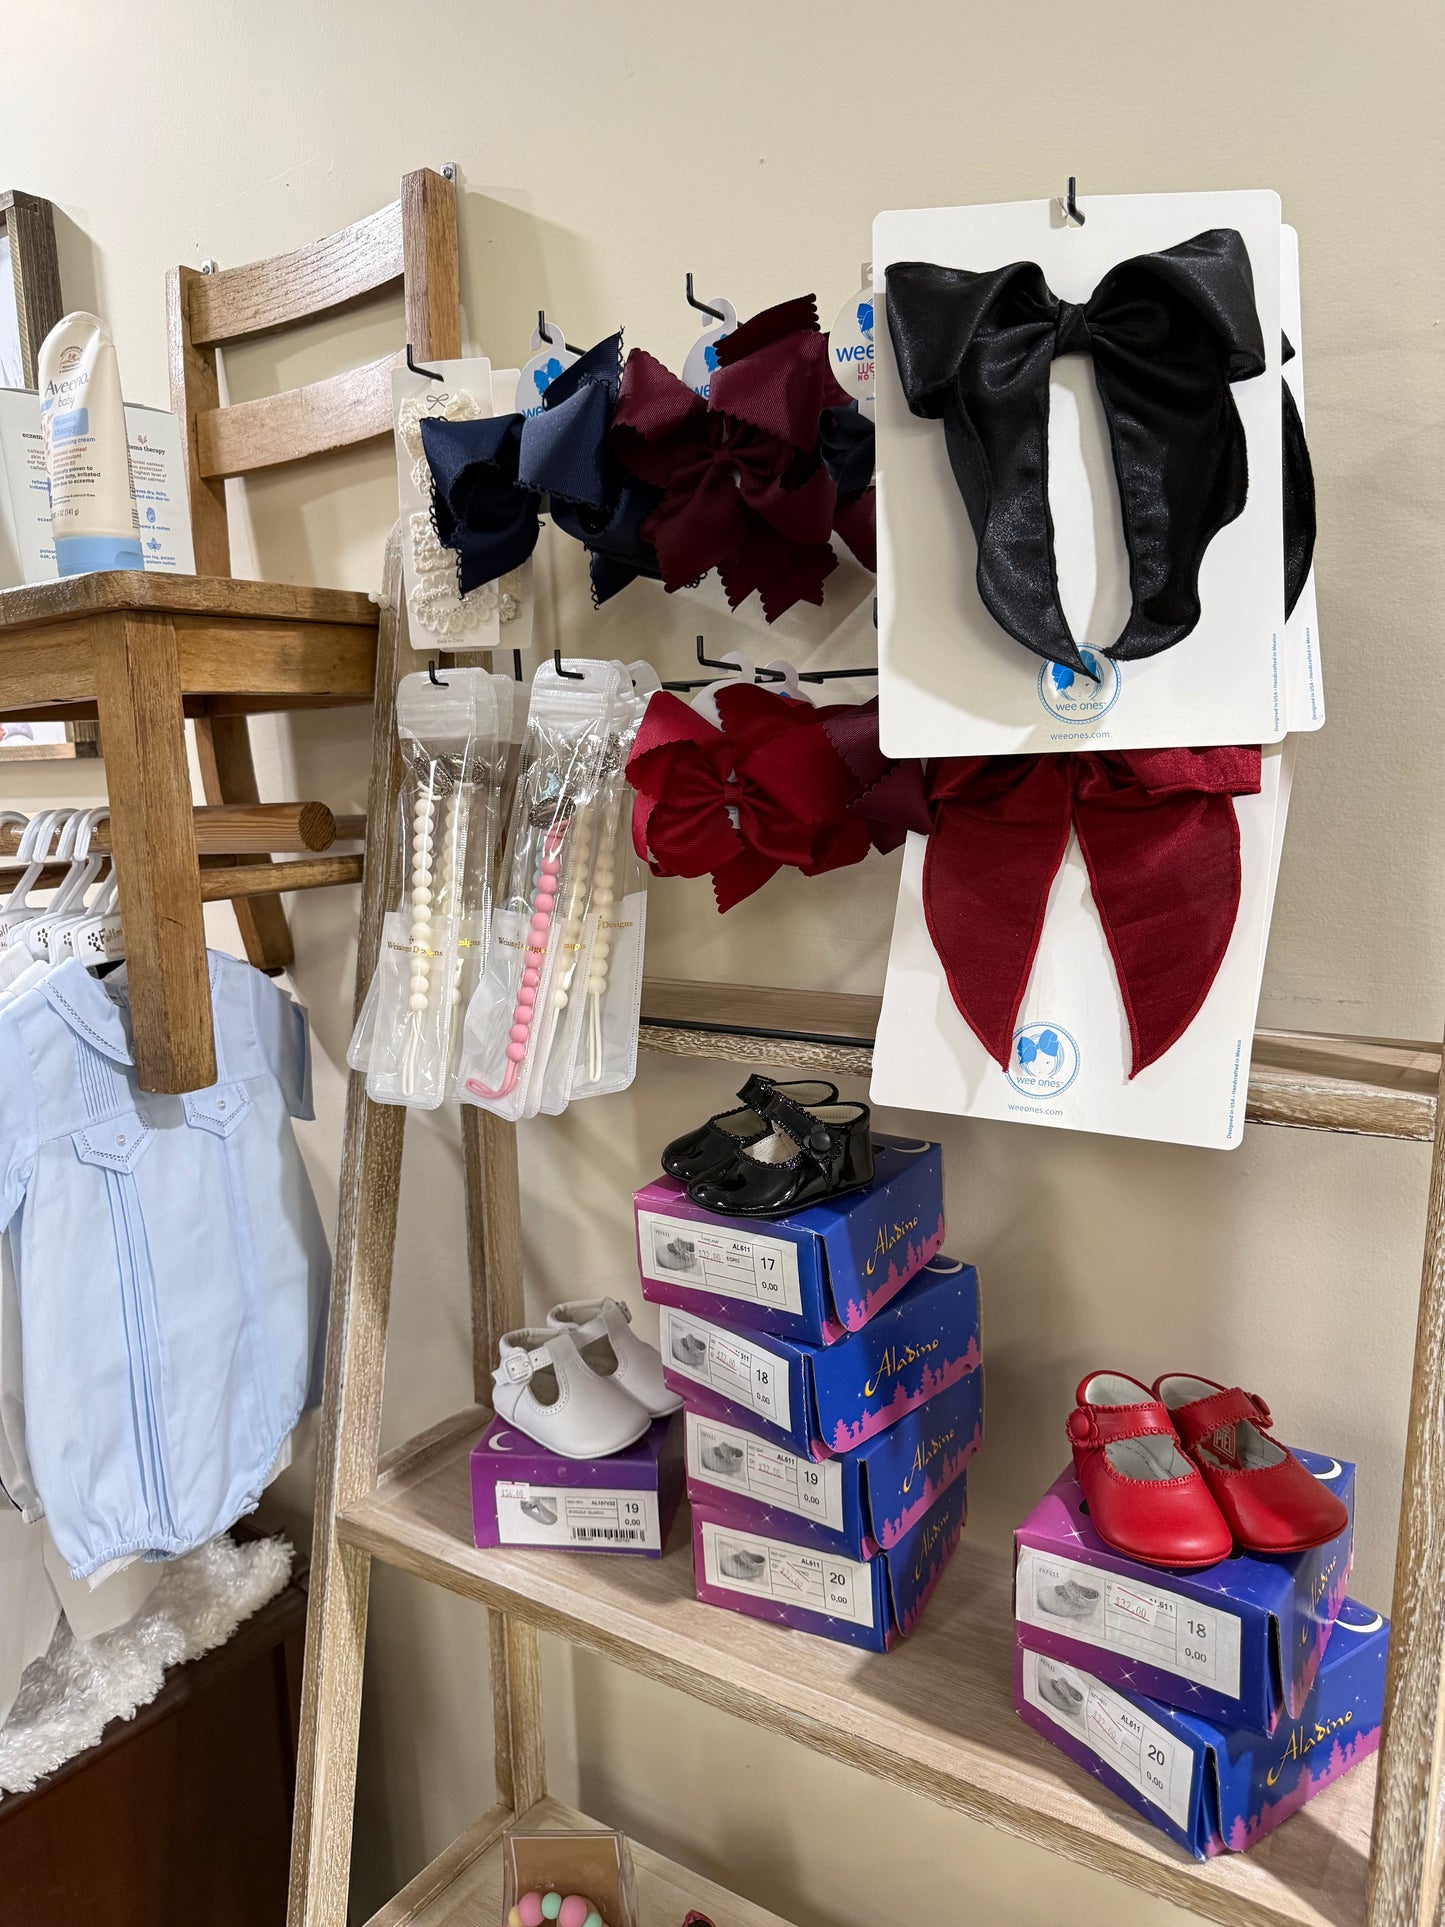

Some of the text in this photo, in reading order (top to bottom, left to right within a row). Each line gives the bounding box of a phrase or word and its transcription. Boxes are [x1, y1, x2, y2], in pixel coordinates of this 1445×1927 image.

[1055, 702, 1104, 711] wee ones
[1050, 731, 1110, 740] weeones.com
[1016, 1077, 1061, 1088] wee ones
[1008, 1104, 1063, 1116] weeones.com
[732, 1243, 751, 1253] AL611
[865, 1215, 919, 1276] Aladino
[761, 1257, 775, 1270] 17
[864, 1338, 939, 1398] Aladino
[756, 1369, 769, 1384] 18
[903, 1428, 955, 1494] Aladino
[804, 1471, 818, 1485] 19
[625, 1503, 639, 1514] 19
[915, 1510, 949, 1581] Aladino
[801, 1558, 820, 1568] AL611
[829, 1572, 846, 1586] 20
[1187, 1620, 1207, 1639] 18
[1121, 1714, 1141, 1733] AL611
[1147, 1744, 1165, 1766] 20
[1266, 1710, 1353, 1786] Aladino
